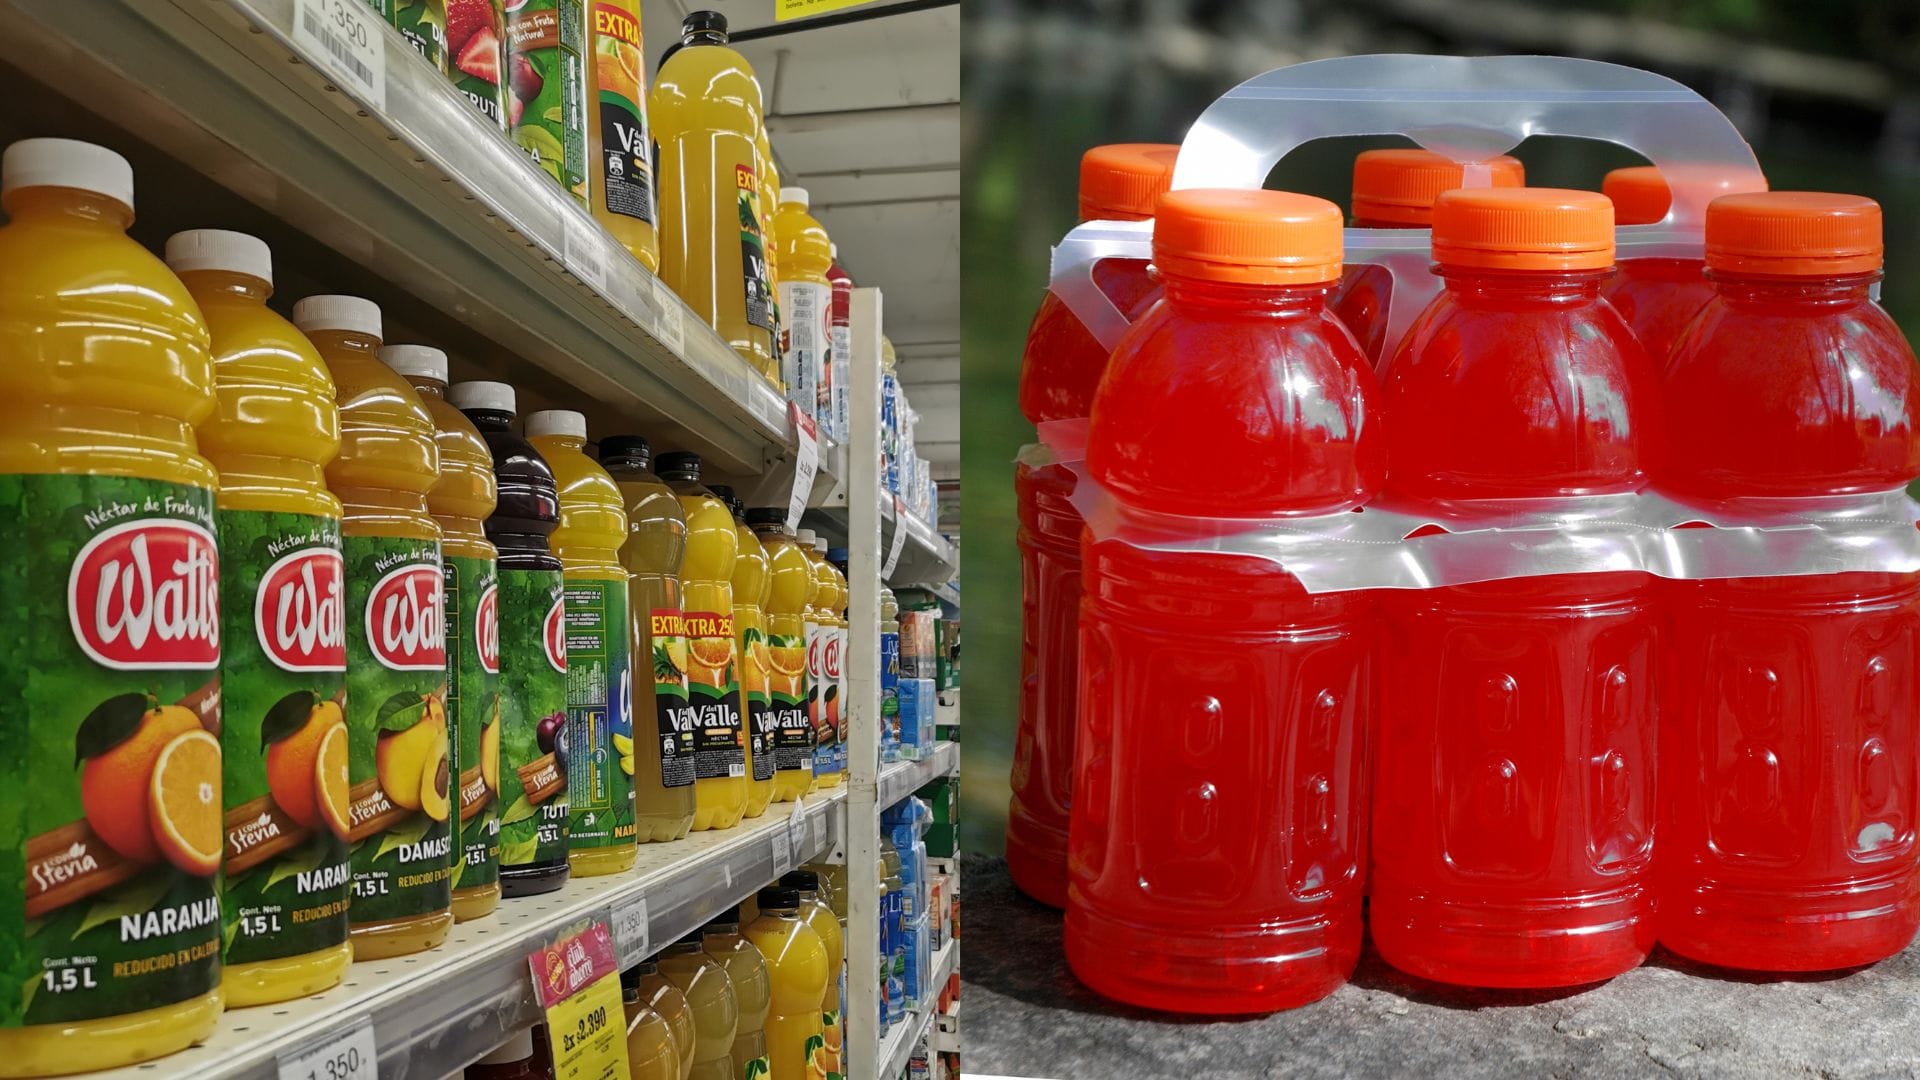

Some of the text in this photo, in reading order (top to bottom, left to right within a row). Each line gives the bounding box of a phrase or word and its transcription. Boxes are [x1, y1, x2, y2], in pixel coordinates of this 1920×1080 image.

[533, 14, 555, 28] Fruta
[595, 10, 640, 49] EXTRA
[513, 28, 545, 44] Natural
[84, 496, 196, 530] Néctar de Fruta
[267, 534, 306, 558] Néctar
[309, 529, 320, 543] de
[374, 552, 408, 574] Néctar
[410, 547, 420, 560] de
[689, 704, 740, 728] Valle
[772, 709, 809, 729] Valle
[533, 771, 559, 790] Stevia
[348, 799, 391, 826] Stevia
[359, 798, 374, 809] con
[242, 822, 261, 833] con
[537, 830, 552, 843] 1,5
[553, 829, 559, 841] L
[229, 823, 280, 854] Stevia
[49, 853, 71, 866] con
[466, 851, 480, 866] 1,5
[481, 850, 486, 862] L
[32, 854, 98, 892] Stevia
[353, 871, 388, 881] Cont. Neto
[398, 873, 433, 888] REDUCIDO
[354, 879, 389, 898] 1,5 L
[121, 896, 219, 942] NARANJA
[239, 905, 282, 917] Cont. Neto
[240, 915, 281, 937] 1,5 L
[113, 953, 176, 977] REDUCIDO
[177, 949, 191, 966] EN
[43, 967, 97, 994] 1,5 L
